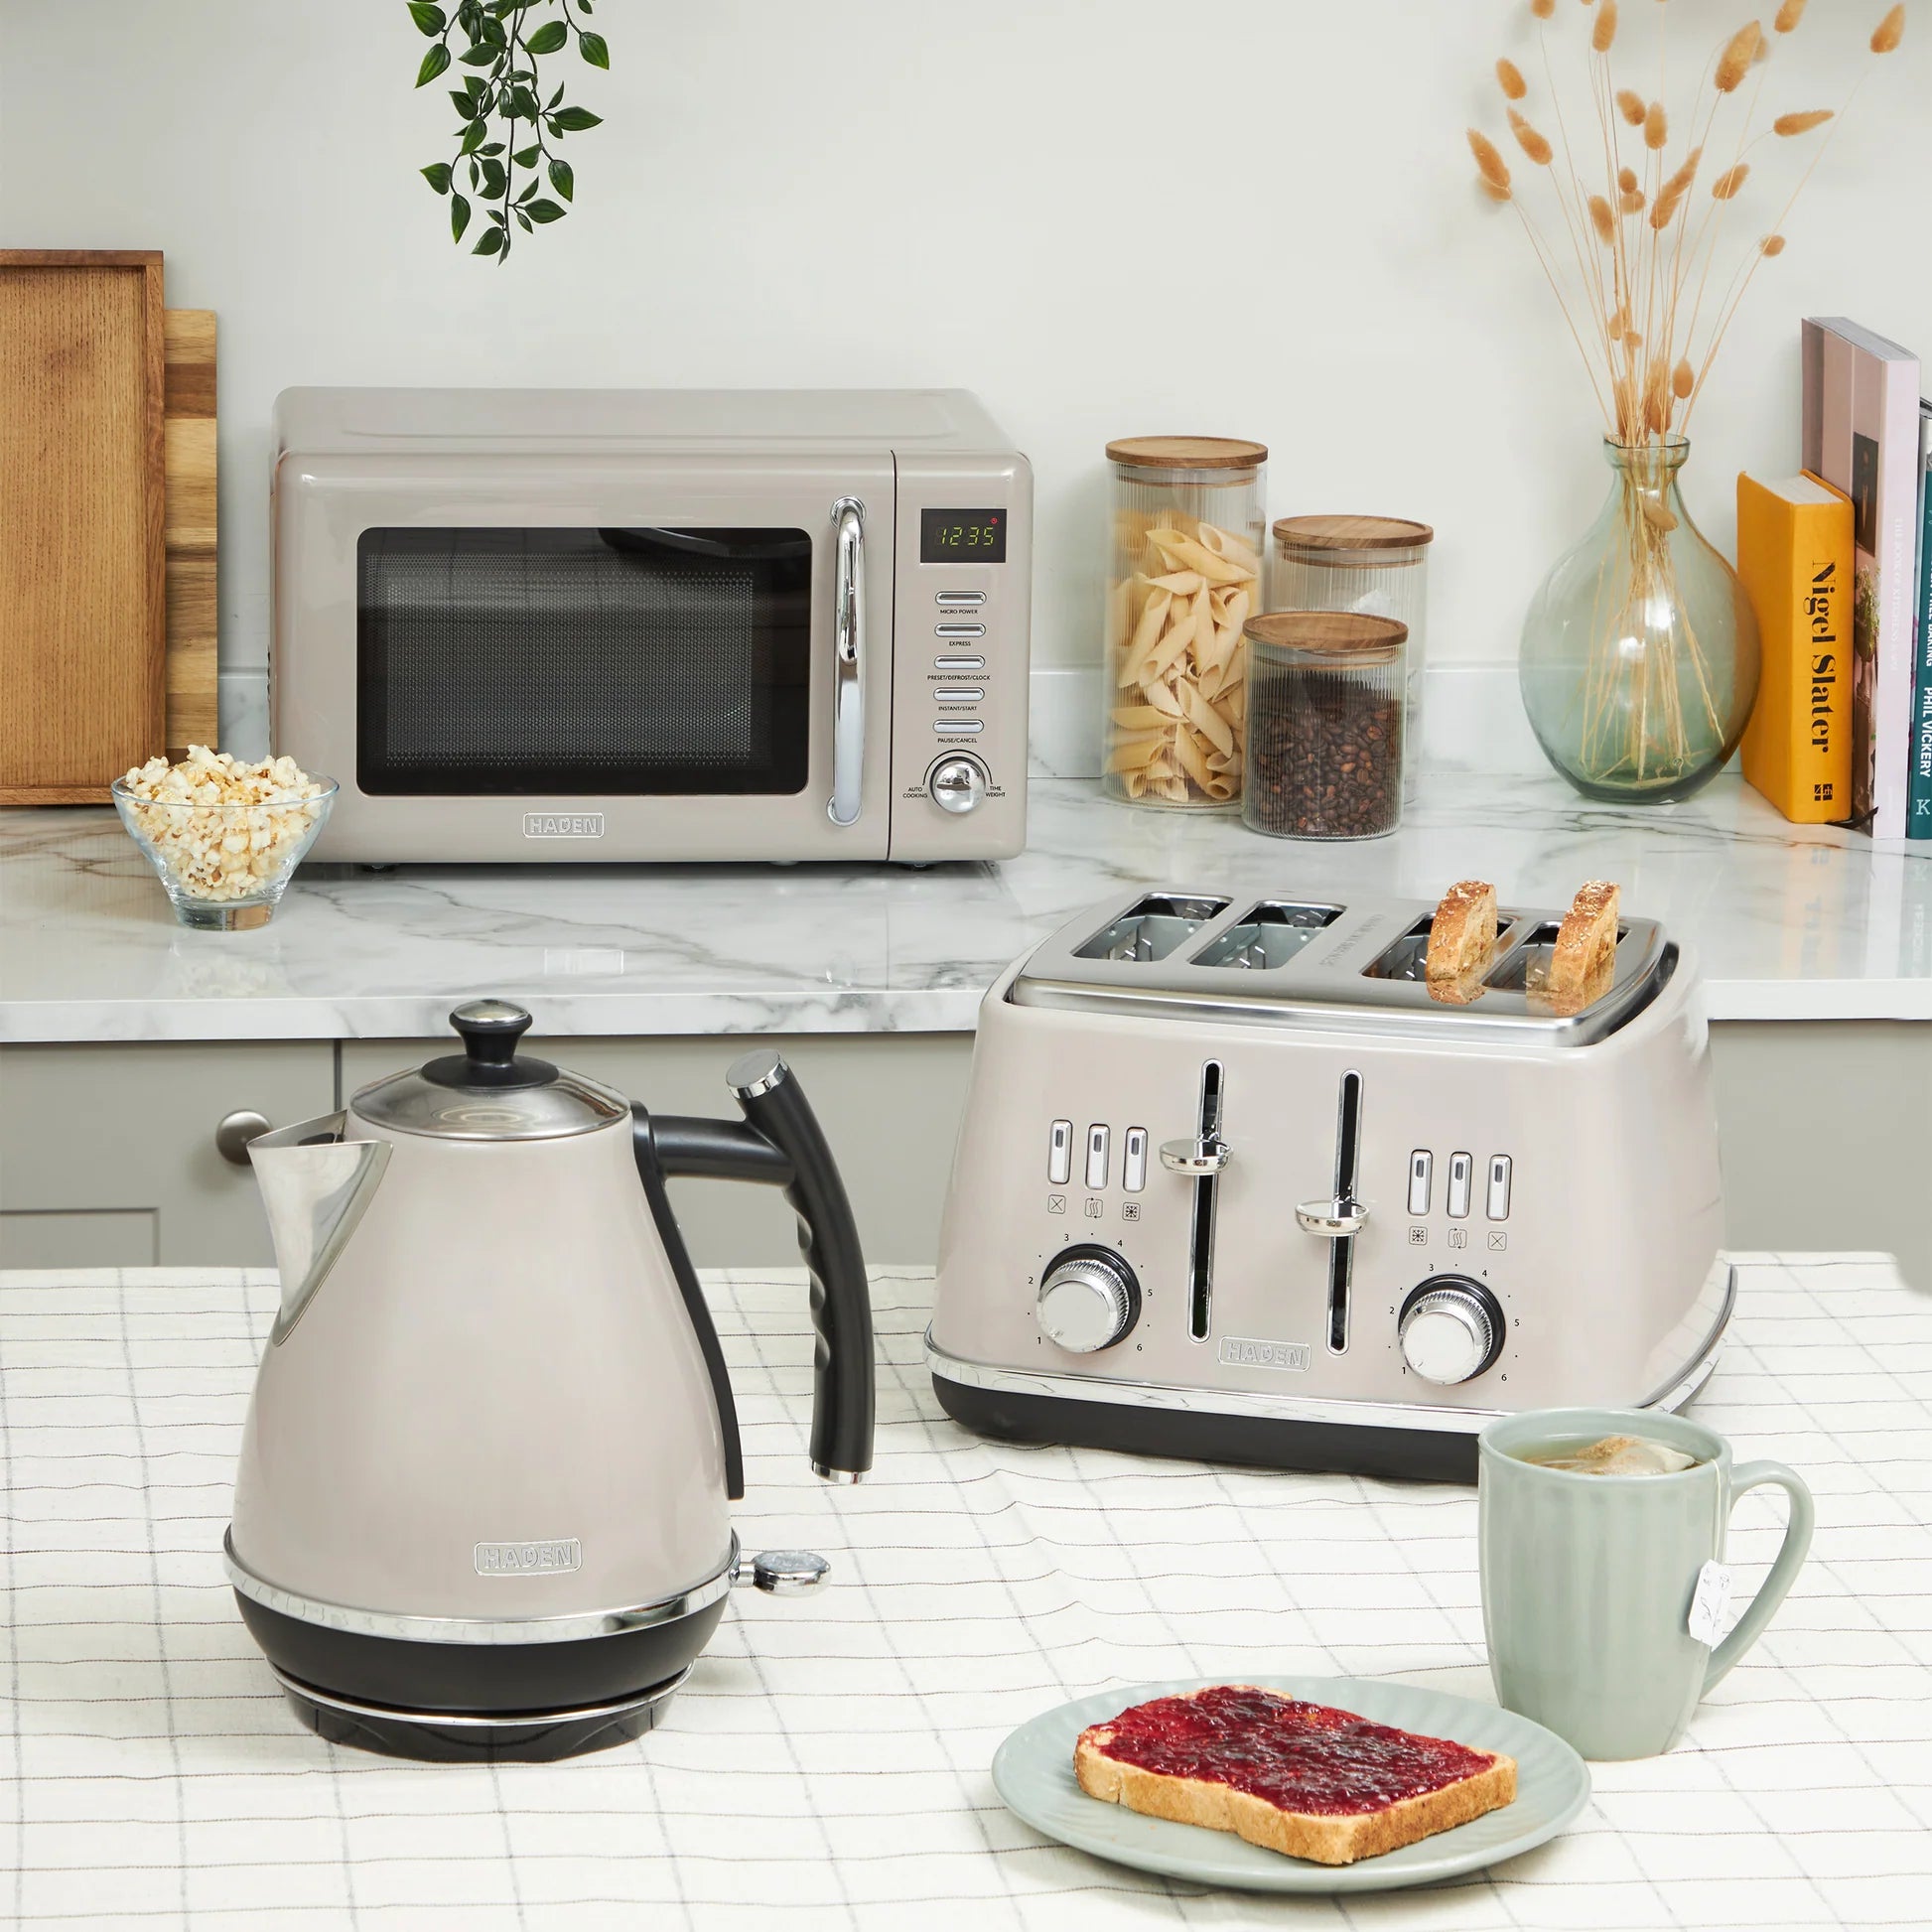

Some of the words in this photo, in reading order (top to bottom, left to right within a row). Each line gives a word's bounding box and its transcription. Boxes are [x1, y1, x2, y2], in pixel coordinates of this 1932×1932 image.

[1802, 559, 1837, 643] Nigel
[1811, 654, 1837, 754] Slater
[1922, 687, 1932, 718] PHIL
[1919, 720, 1932, 778] VICKERY
[1915, 798, 1932, 815] K
[529, 817, 600, 834] HADEN
[1063, 1233, 1070, 1242] 3
[1117, 1239, 1123, 1248] 4
[1429, 1263, 1435, 1272] 3
[1481, 1269, 1488, 1278] 4
[1028, 1276, 1034, 1285] 2
[1148, 1288, 1154, 1297] 5
[1036, 1336, 1041, 1345] 1
[1136, 1343, 1143, 1352] 6
[1226, 1341, 1305, 1367] HADEN
[1402, 1366, 1406, 1375] 1
[1501, 1373, 1507, 1382] 6
[483, 1544, 574, 1570] HADEN
